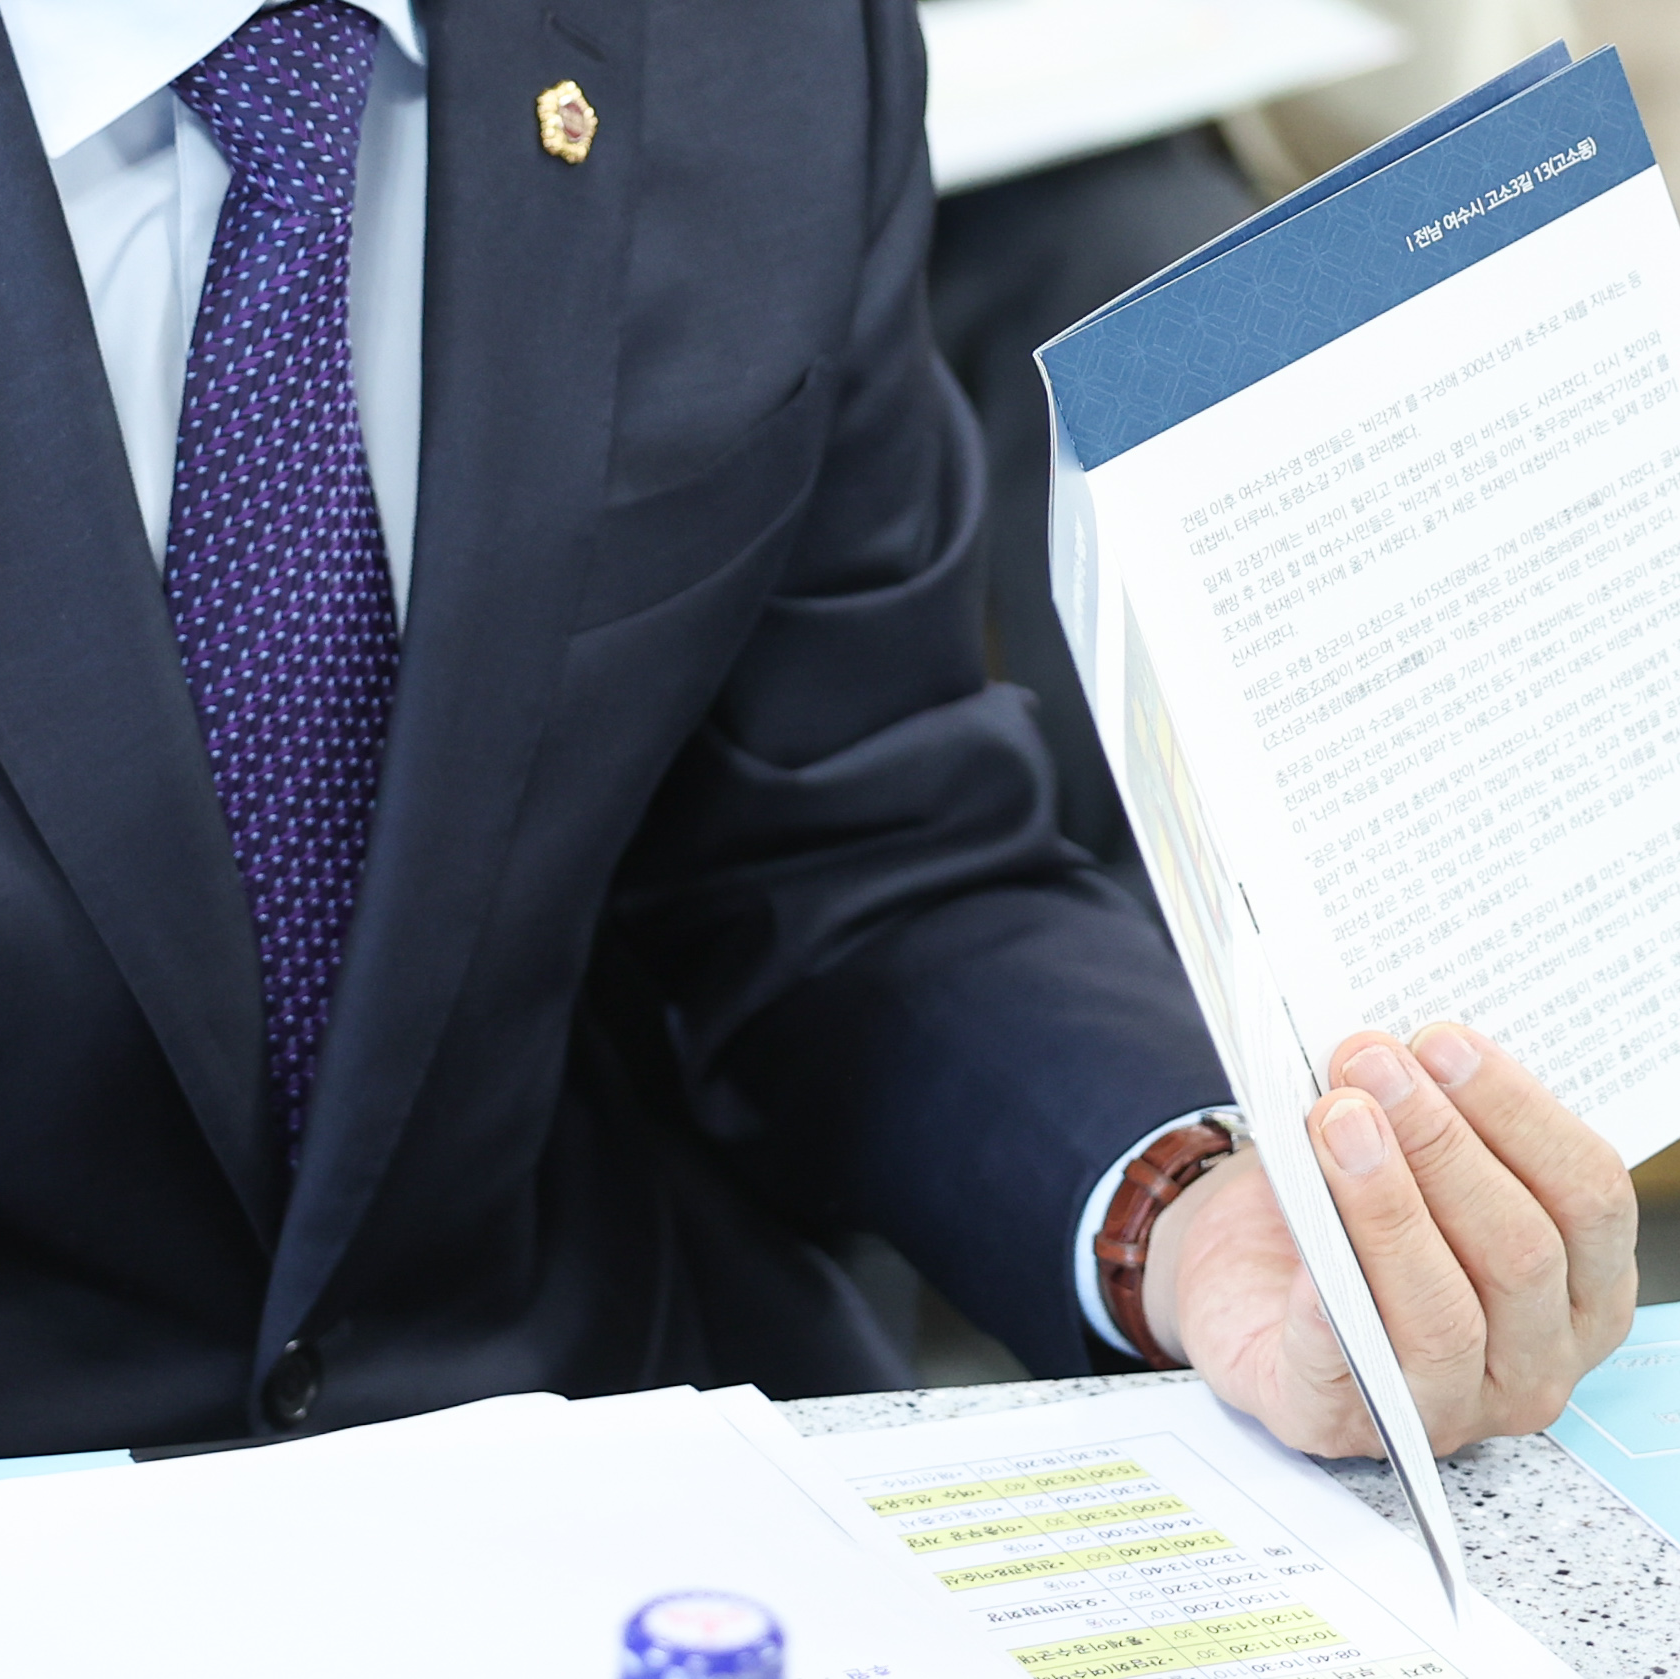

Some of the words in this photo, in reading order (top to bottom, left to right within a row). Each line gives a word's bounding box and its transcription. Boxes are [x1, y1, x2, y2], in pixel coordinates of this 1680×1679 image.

[1412, 218, 1444, 249] 전남
[1442, 196, 1486, 230] 여수시
[1483, 170, 1535, 211] 고소3길
[1532, 135, 1597, 183] 13(고소동)
[1179, 505, 1210, 534] 건립
[1208, 492, 1238, 516] 이후
[1237, 455, 1304, 500] 여수좌수영
[1302, 427, 1356, 468] 영민들은
[1419, 370, 1460, 403] 구성해
[1457, 349, 1497, 383] 300년
[1494, 334, 1524, 363] 넘게
[1524, 313, 1563, 348] 춘추로
[1561, 298, 1589, 323] 제를
[1588, 280, 1627, 308] 지내는
[1201, 566, 1233, 595] 일제
[1233, 531, 1304, 578] 강점기에는
[1304, 503, 1348, 536] 비각이
[1349, 479, 1392, 515] 헐리고
[1392, 448, 1448, 488] 대첩비와
[1478, 401, 1534, 440] 비석들도
[1536, 370, 1593, 410] 사라졌다.
[1592, 351, 1621, 376] 다시
[1188, 524, 1235, 556] 대첩비,
[1232, 500, 1279, 533] 타루비,
[1329, 451, 1366, 483] 3기를
[1365, 422, 1422, 463] 관리했다.
[1220, 608, 1264, 644] 조직해
[1263, 585, 1306, 621] 현재의
[1305, 562, 1348, 597] 위치에
[1347, 546, 1377, 575] 옮겨
[1377, 523, 1422, 556] 세웠다.
[1421, 505, 1450, 534] 옮겨
[1450, 490, 1478, 516] 세운
[1479, 466, 1519, 501] 현재의
[1518, 437, 1571, 476] 대첩비각
[1571, 418, 1611, 448] 위치는
[1611, 398, 1640, 426] 일제
[1639, 376, 1679, 410] 강점기
[1211, 591, 1240, 617] 해방
[1256, 566, 1286, 595] 건립
[1318, 506, 1396, 558] 여수시민들은
[1459, 449, 1498, 483] 정신을
[1498, 433, 1527, 458] 이어
[1241, 669, 1284, 702] 비문은
[1312, 629, 1355, 665] 장군의
[1355, 600, 1408, 641] 요청으로
[1617, 459, 1660, 491] 지었다.
[1230, 620, 1299, 669] 신사터였다.
[1068, 1446, 1120, 1462] 16:30
[1014, 1455, 1066, 1470] 18:20
[1088, 1462, 1142, 1479] 15:50
[1034, 1472, 1087, 1487] 16:30
[1108, 1481, 1161, 1496] 15:30
[1055, 1489, 1107, 1505] 15:50
[1075, 1506, 1129, 1522] 15:30
[1130, 1498, 1183, 1514] 15:00
[1150, 1515, 1204, 1531] 14:40
[1096, 1524, 1149, 1539] 15:00
[1117, 1541, 1171, 1557] 14:40
[1172, 1533, 1226, 1549] 13:40
[1193, 1551, 1247, 1567] 13:20
[1138, 1560, 1192, 1576] 13:40
[1215, 1570, 1269, 1586] 12:00
[1159, 1579, 1214, 1595] 13:20
[1236, 1589, 1291, 1605] 11:50
[1181, 1598, 1236, 1615] 12:00
[1259, 1608, 1315, 1626] 11:20
[1204, 1618, 1259, 1634] 11:50
[1283, 1628, 1338, 1645] 10:50
[1227, 1638, 1282, 1655] 11:20
[1305, 1647, 1361, 1664] 08:40
[1042, 1654, 1168, 1679] 간담회(여수여
[1249, 1657, 1305, 1673] 10:30
